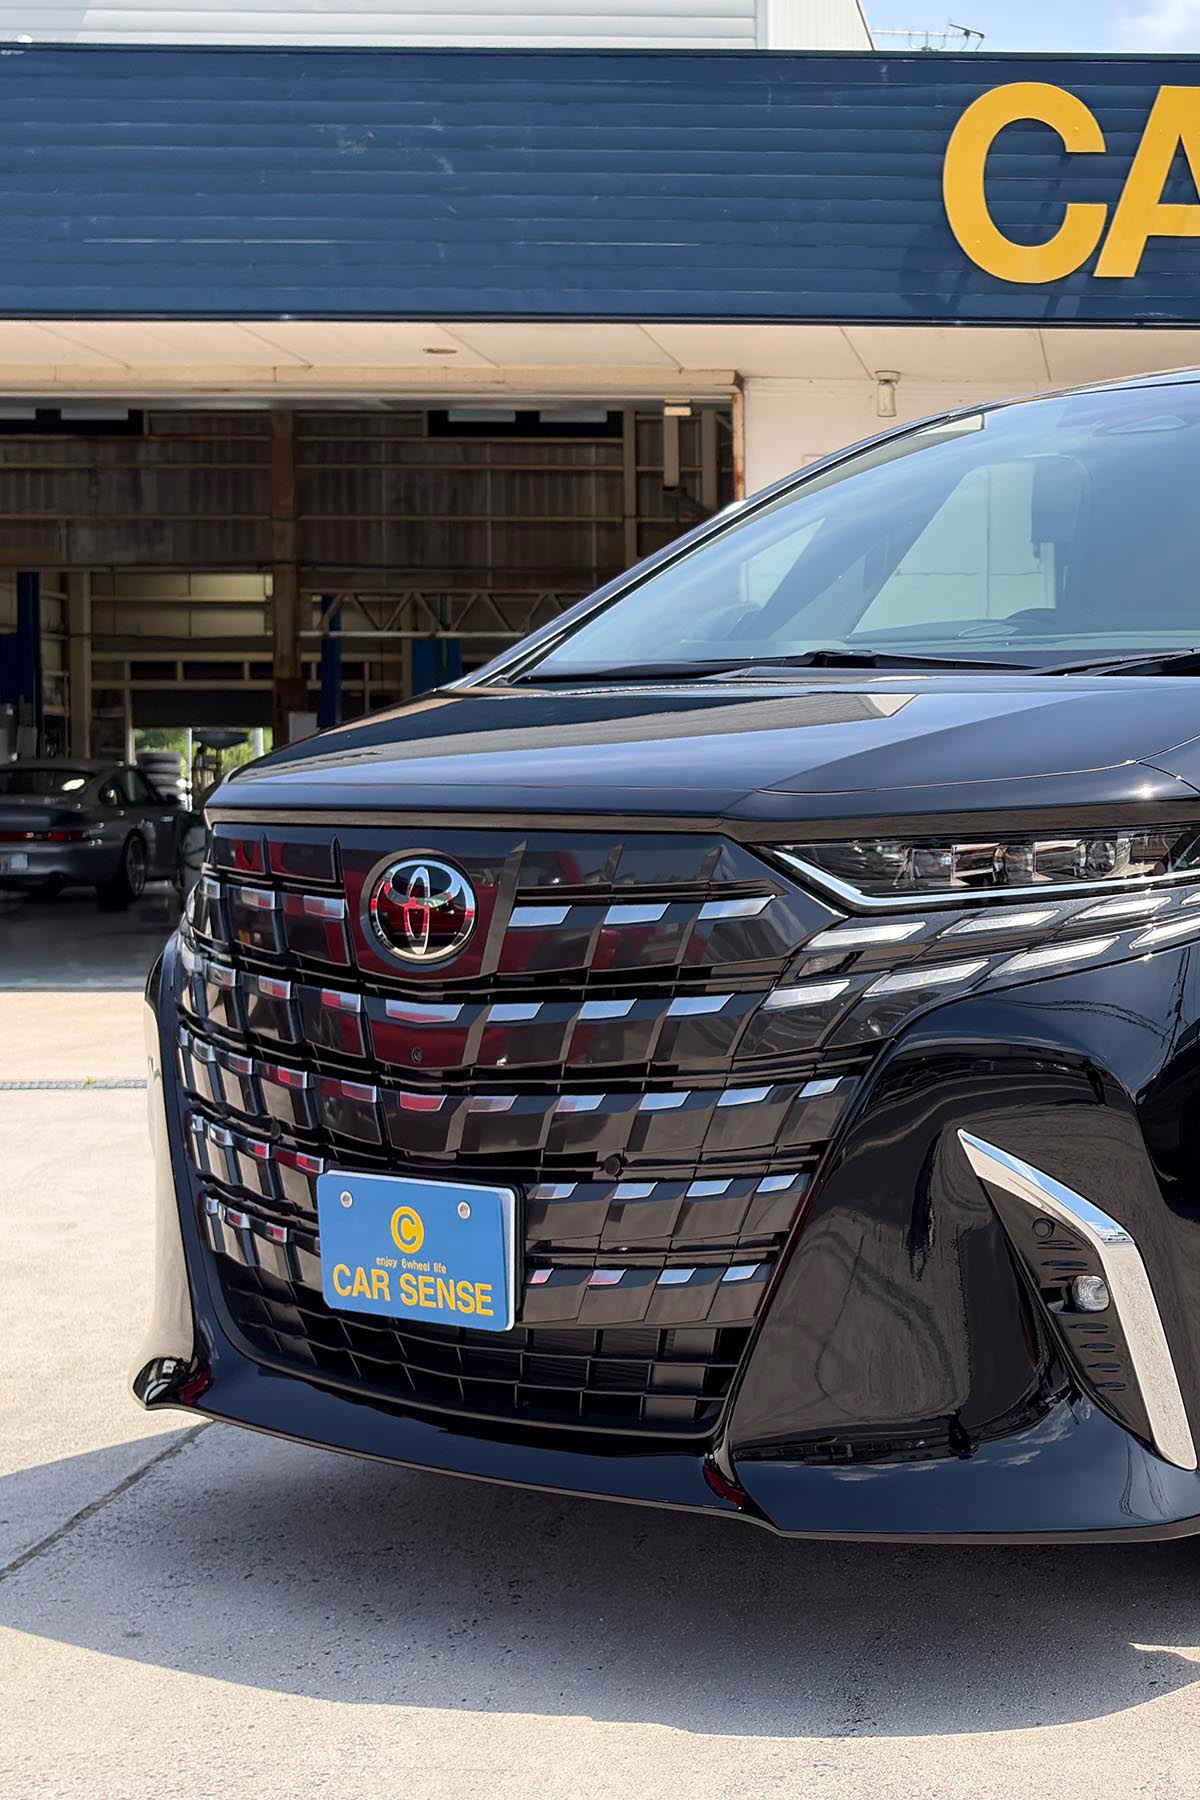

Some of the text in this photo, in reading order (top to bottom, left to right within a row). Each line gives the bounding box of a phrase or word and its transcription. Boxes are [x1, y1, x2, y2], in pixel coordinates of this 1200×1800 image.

[376, 1256, 397, 1269] enjoy
[333, 1263, 494, 1317] CAR SENSE
